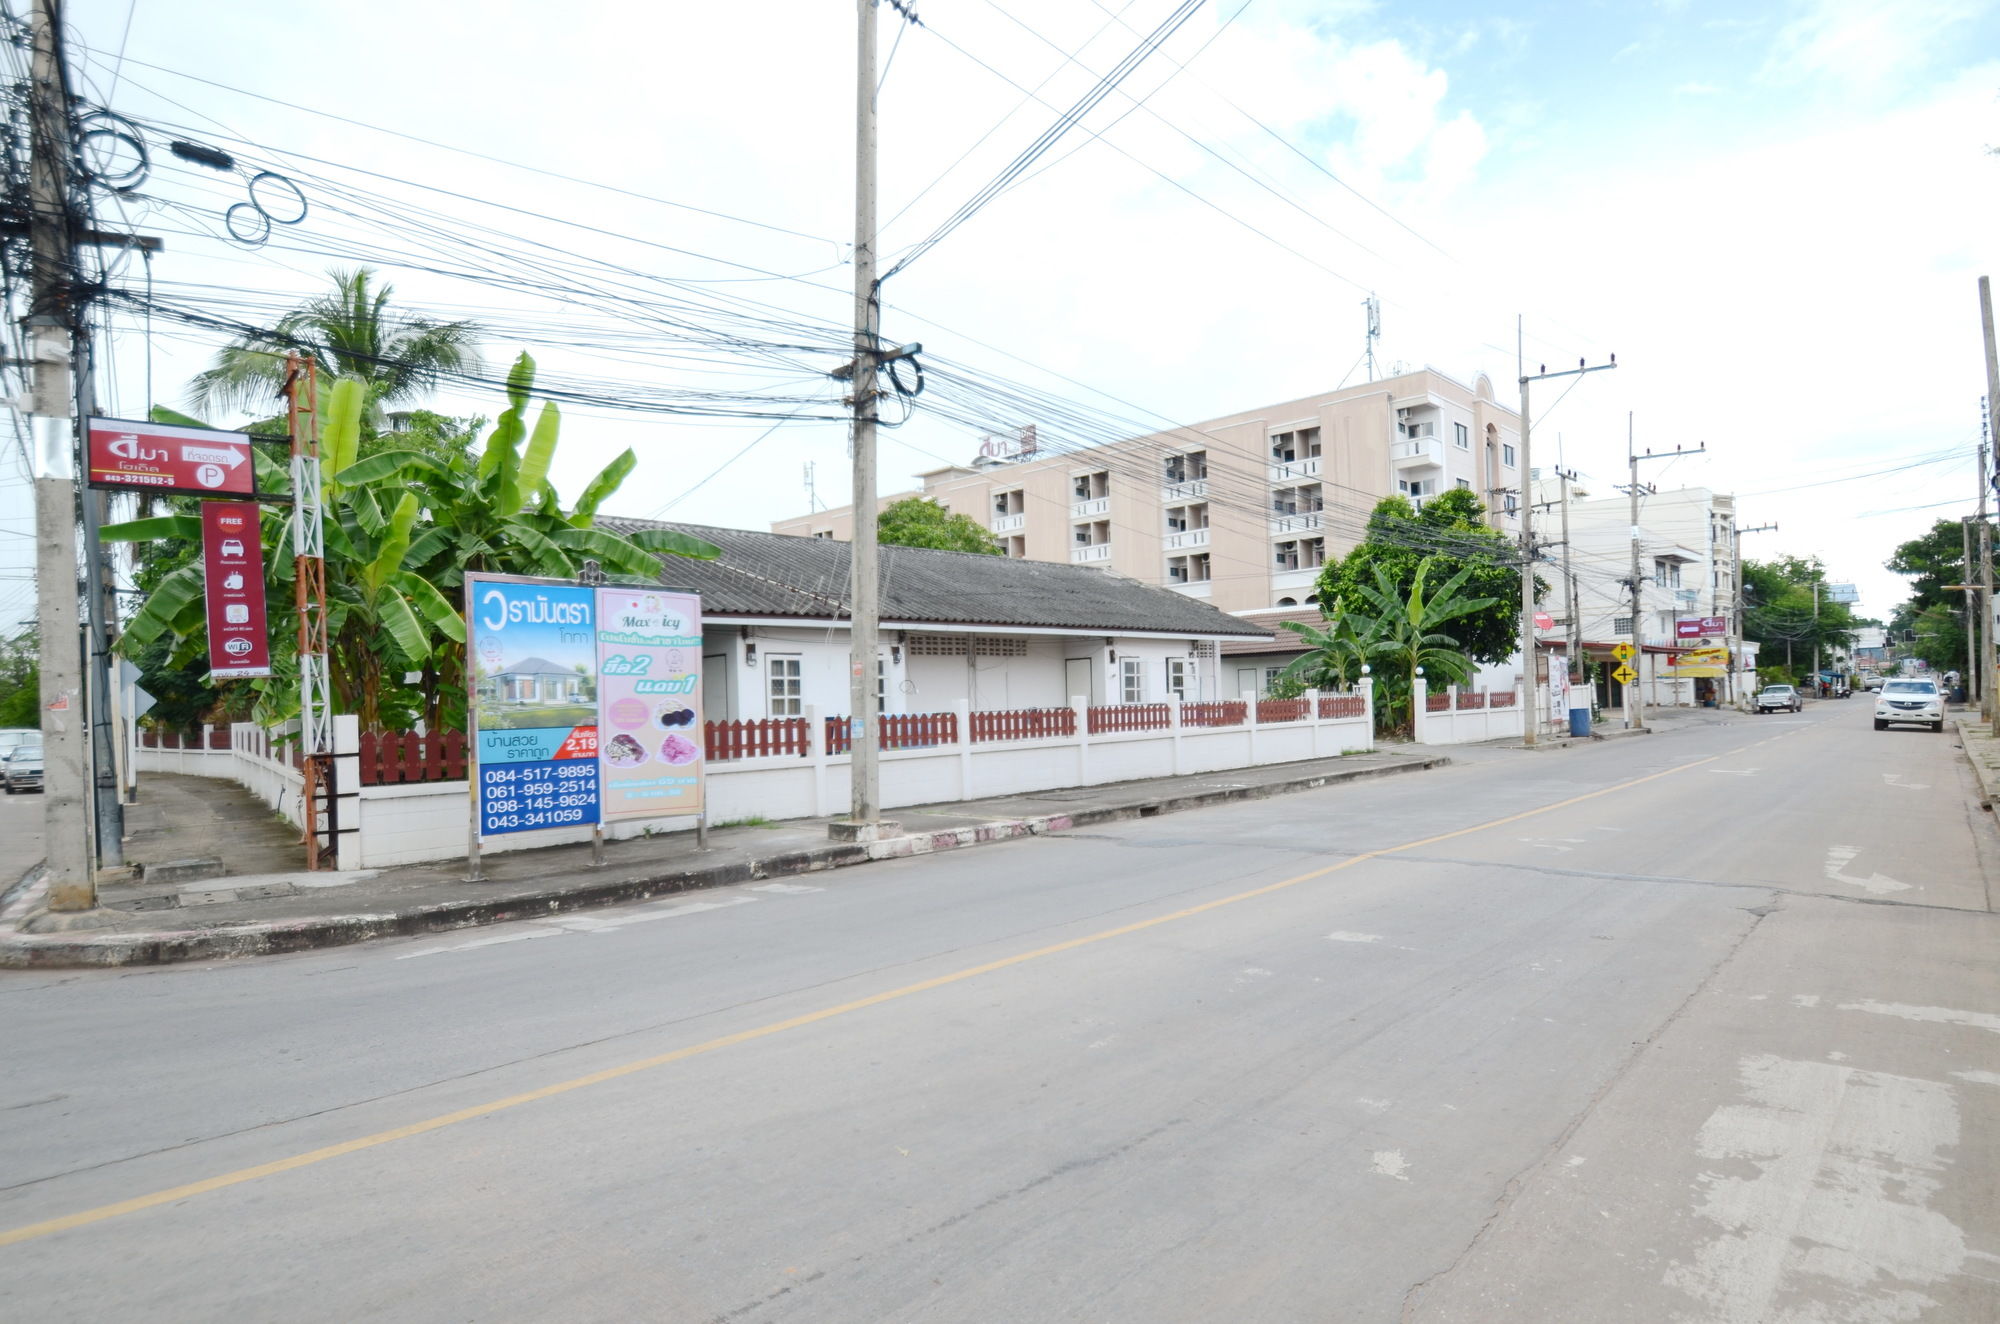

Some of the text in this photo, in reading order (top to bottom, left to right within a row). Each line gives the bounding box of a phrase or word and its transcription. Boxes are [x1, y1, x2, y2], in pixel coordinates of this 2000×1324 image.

[109, 434, 168, 462] ดีมา
[205, 467, 218, 484] P
[220, 517, 243, 526] FREE
[483, 590, 591, 632] วรามันตรา
[487, 731, 538, 748] บ้านสวย
[566, 738, 597, 751] 2.19
[507, 747, 550, 760] ราคาถูก
[485, 764, 595, 784] 084-517-9895
[486, 779, 597, 799] 061-959-2514
[486, 792, 597, 814] 098-145-9624
[487, 808, 583, 829] 043-341059
